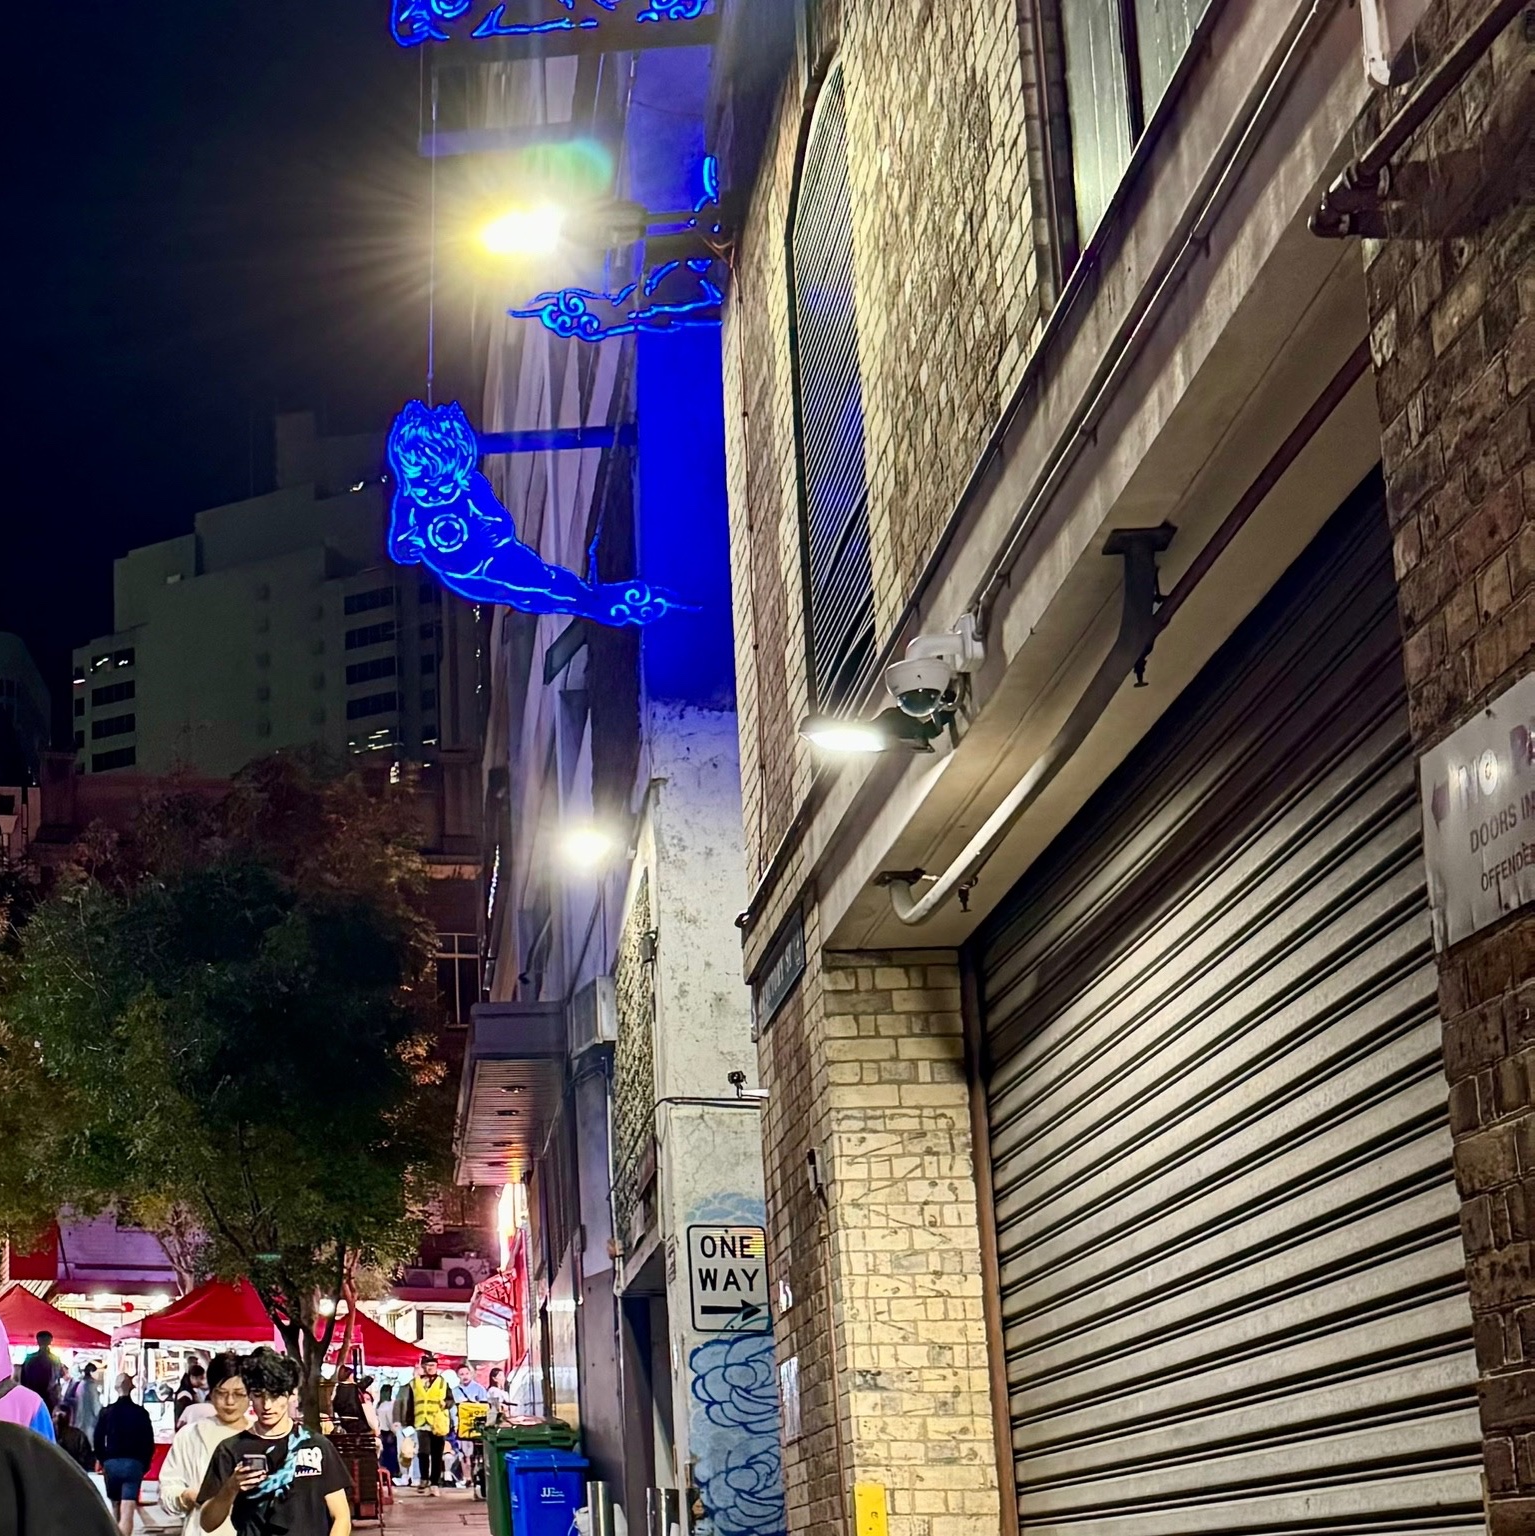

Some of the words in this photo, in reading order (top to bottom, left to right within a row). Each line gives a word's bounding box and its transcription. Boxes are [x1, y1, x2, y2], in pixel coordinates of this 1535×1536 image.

[1469, 803, 1518, 854] DOORS
[700, 1235, 756, 1259] ONE
[698, 1268, 760, 1292] WAY
